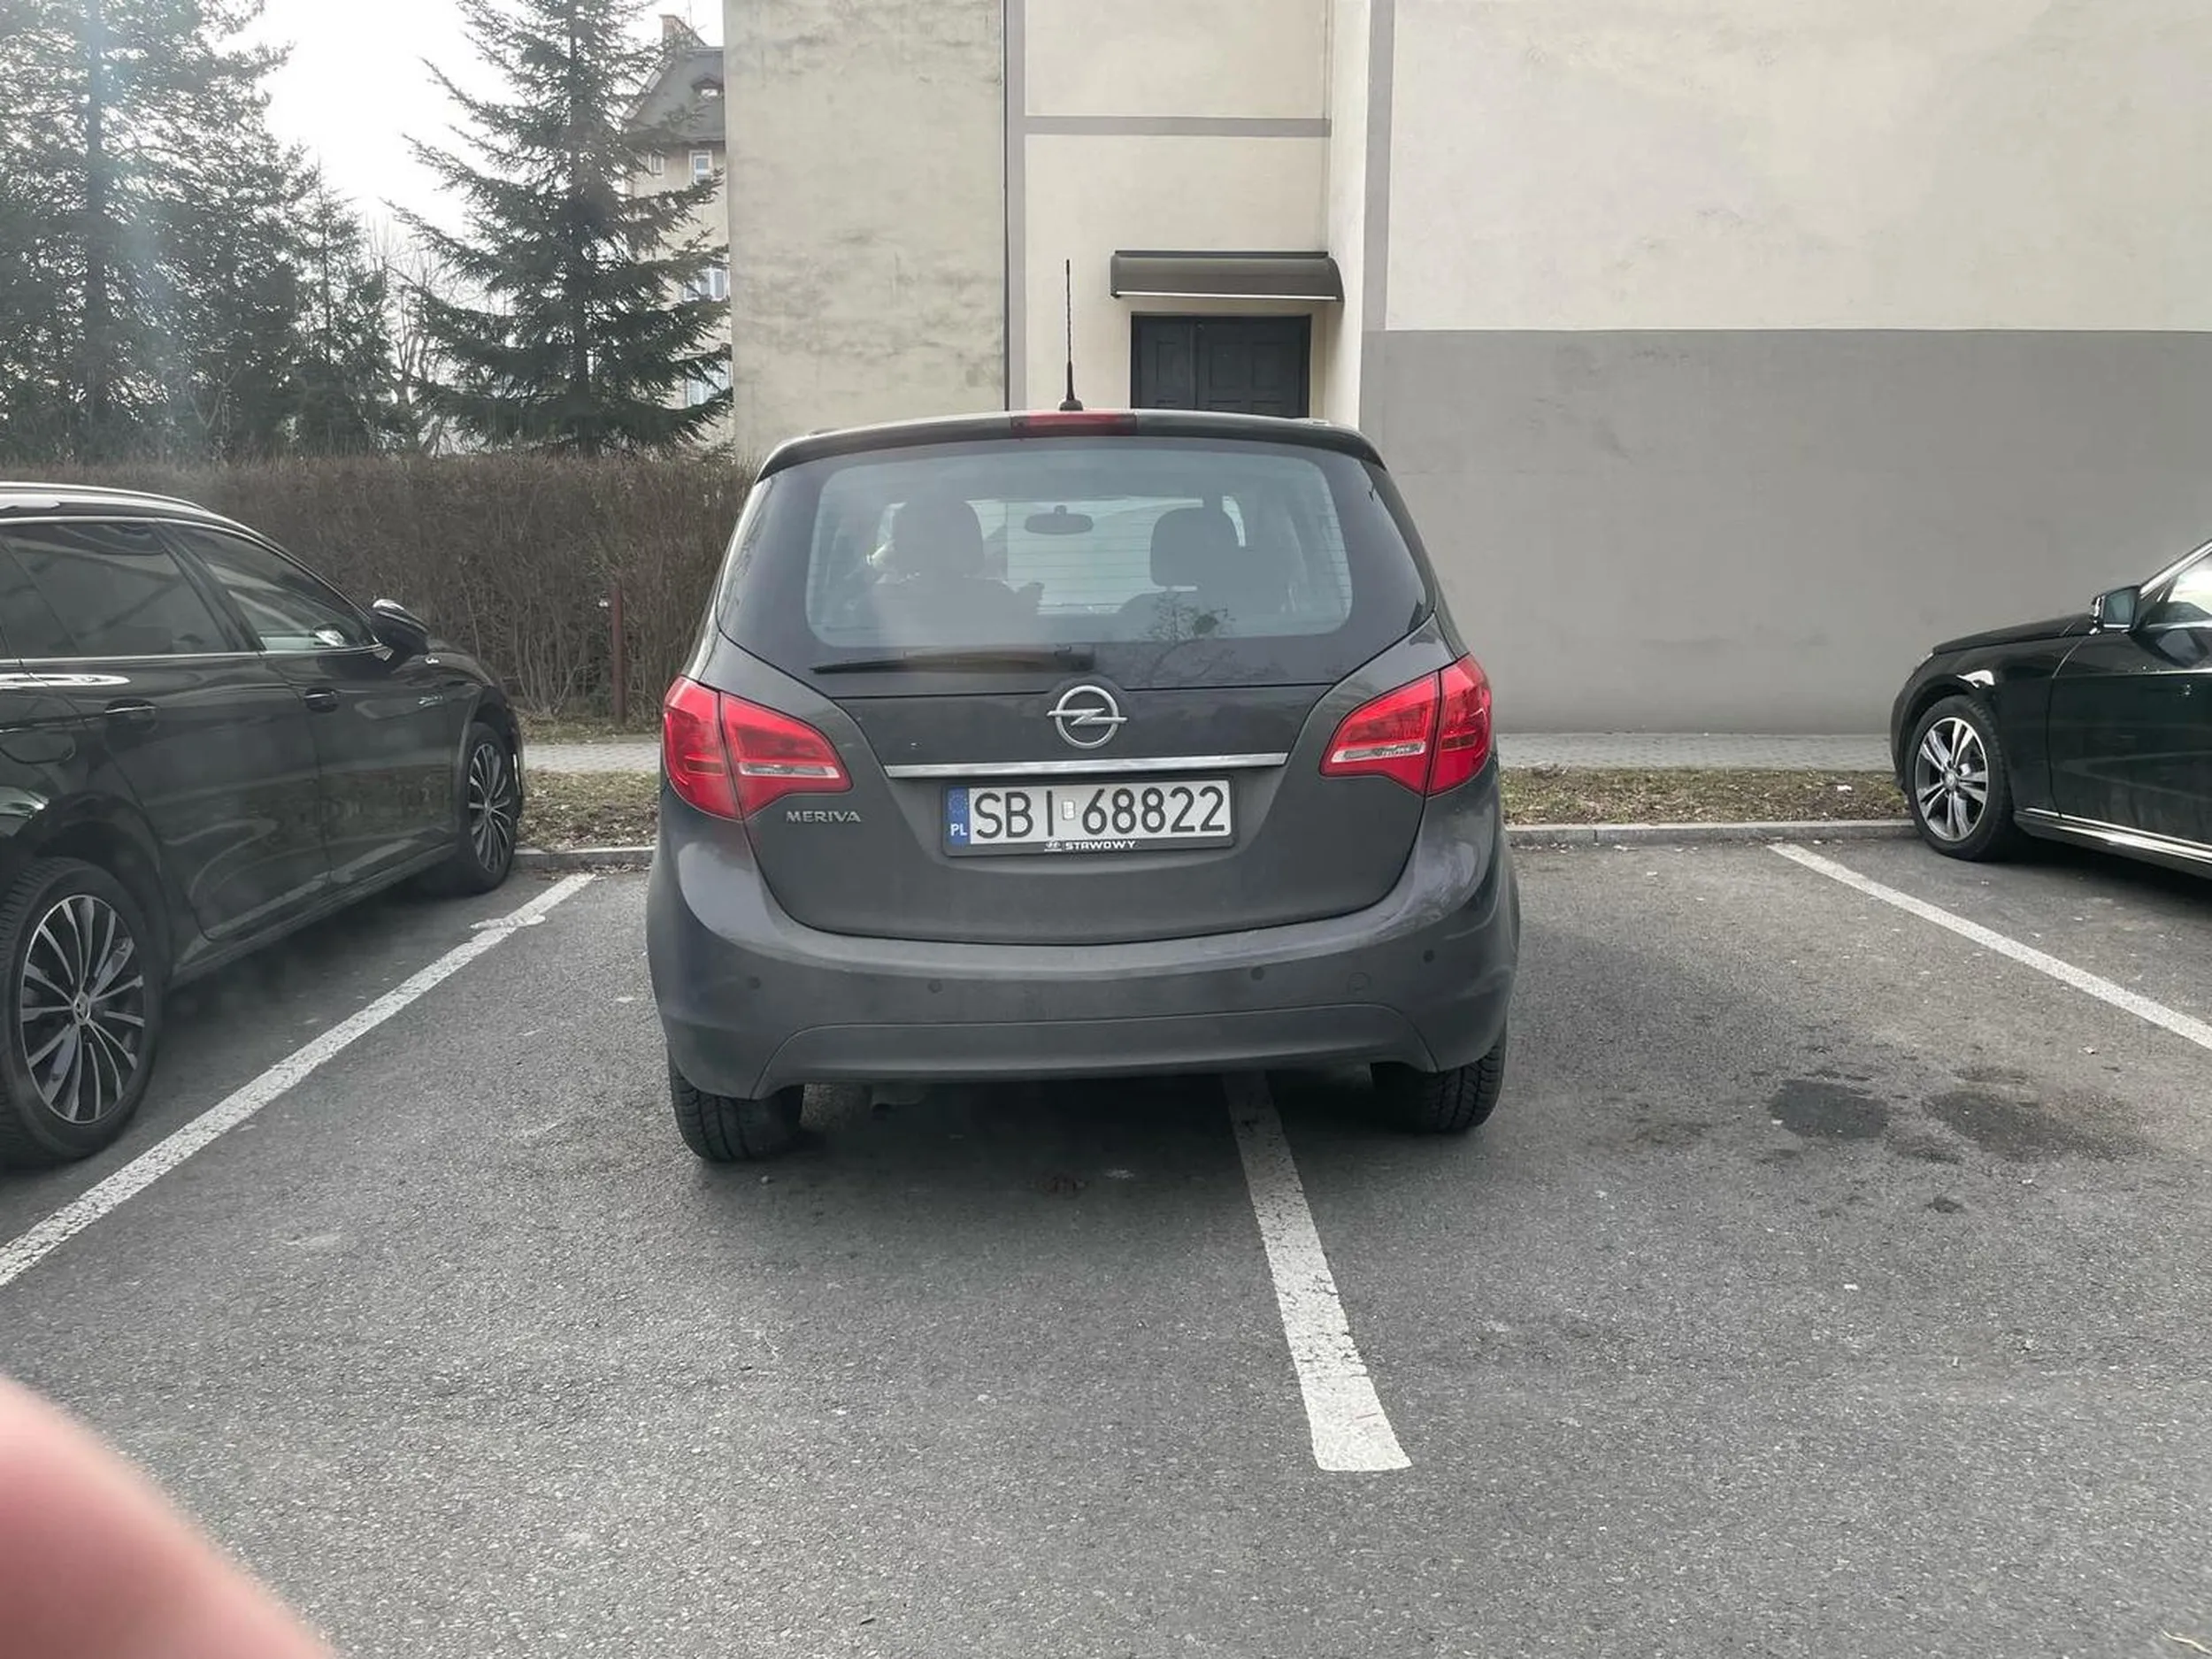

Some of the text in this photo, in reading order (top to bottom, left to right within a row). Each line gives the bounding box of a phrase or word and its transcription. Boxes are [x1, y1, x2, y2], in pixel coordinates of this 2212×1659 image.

[786, 810, 862, 823] MERIVA
[973, 786, 1225, 839] SBI 68822
[950, 823, 968, 836] PL
[1064, 840, 1136, 850] STAWOWY
